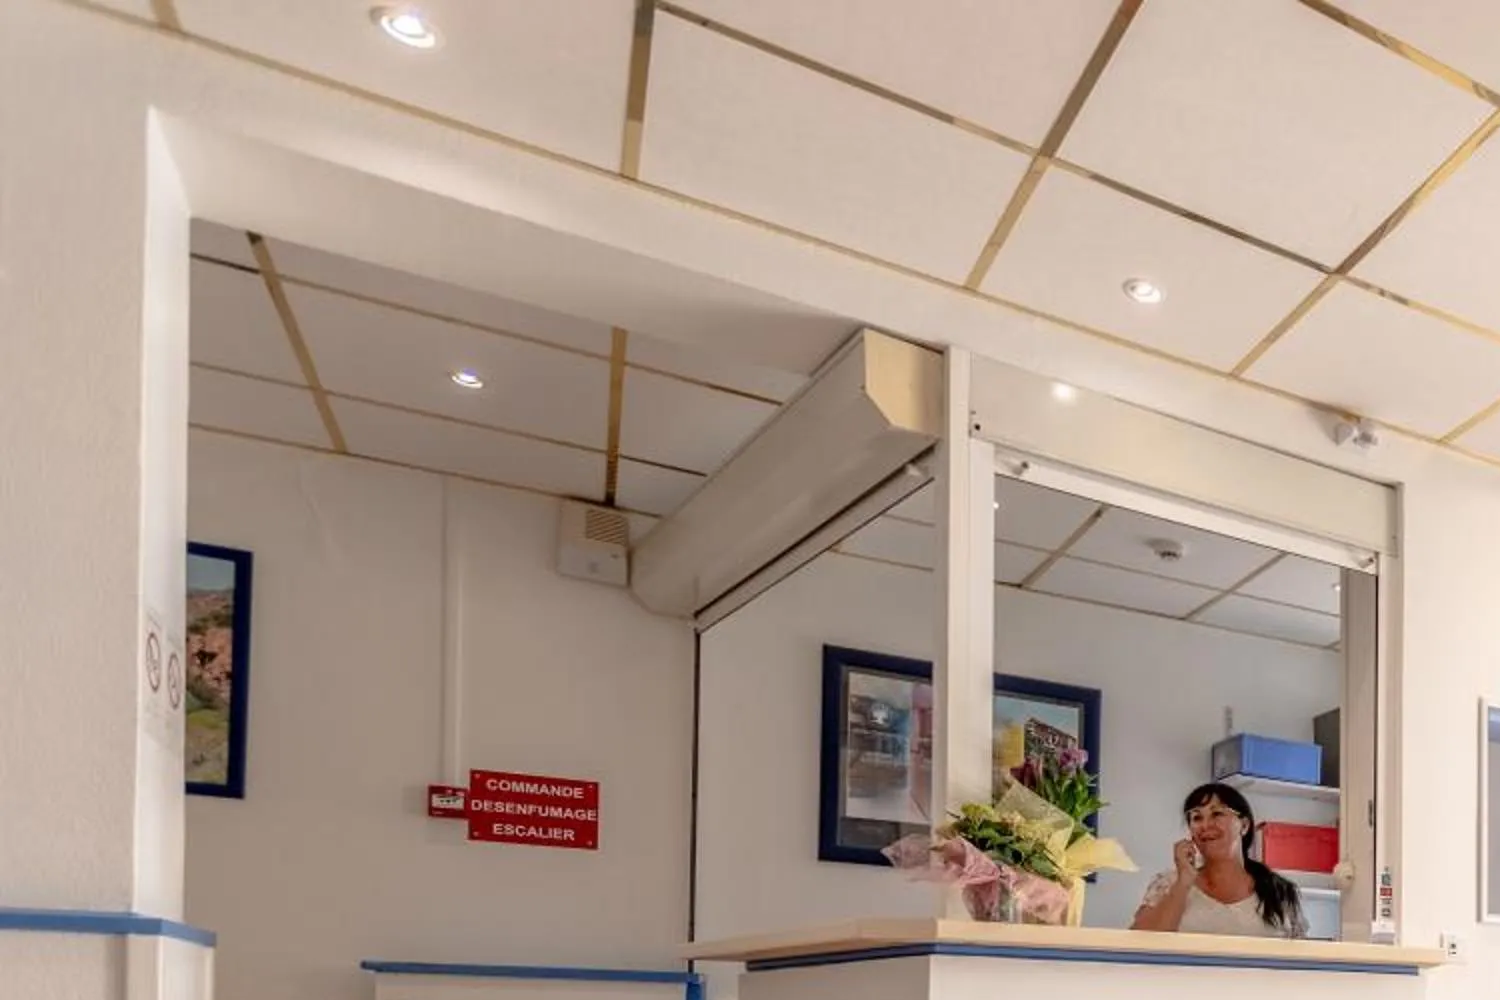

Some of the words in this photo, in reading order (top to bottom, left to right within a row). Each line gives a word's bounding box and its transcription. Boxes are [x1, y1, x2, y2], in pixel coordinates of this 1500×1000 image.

[486, 779, 585, 799] COMMANDE
[471, 799, 597, 821] DESENFUMAGE
[493, 822, 575, 841] ESCALIER
